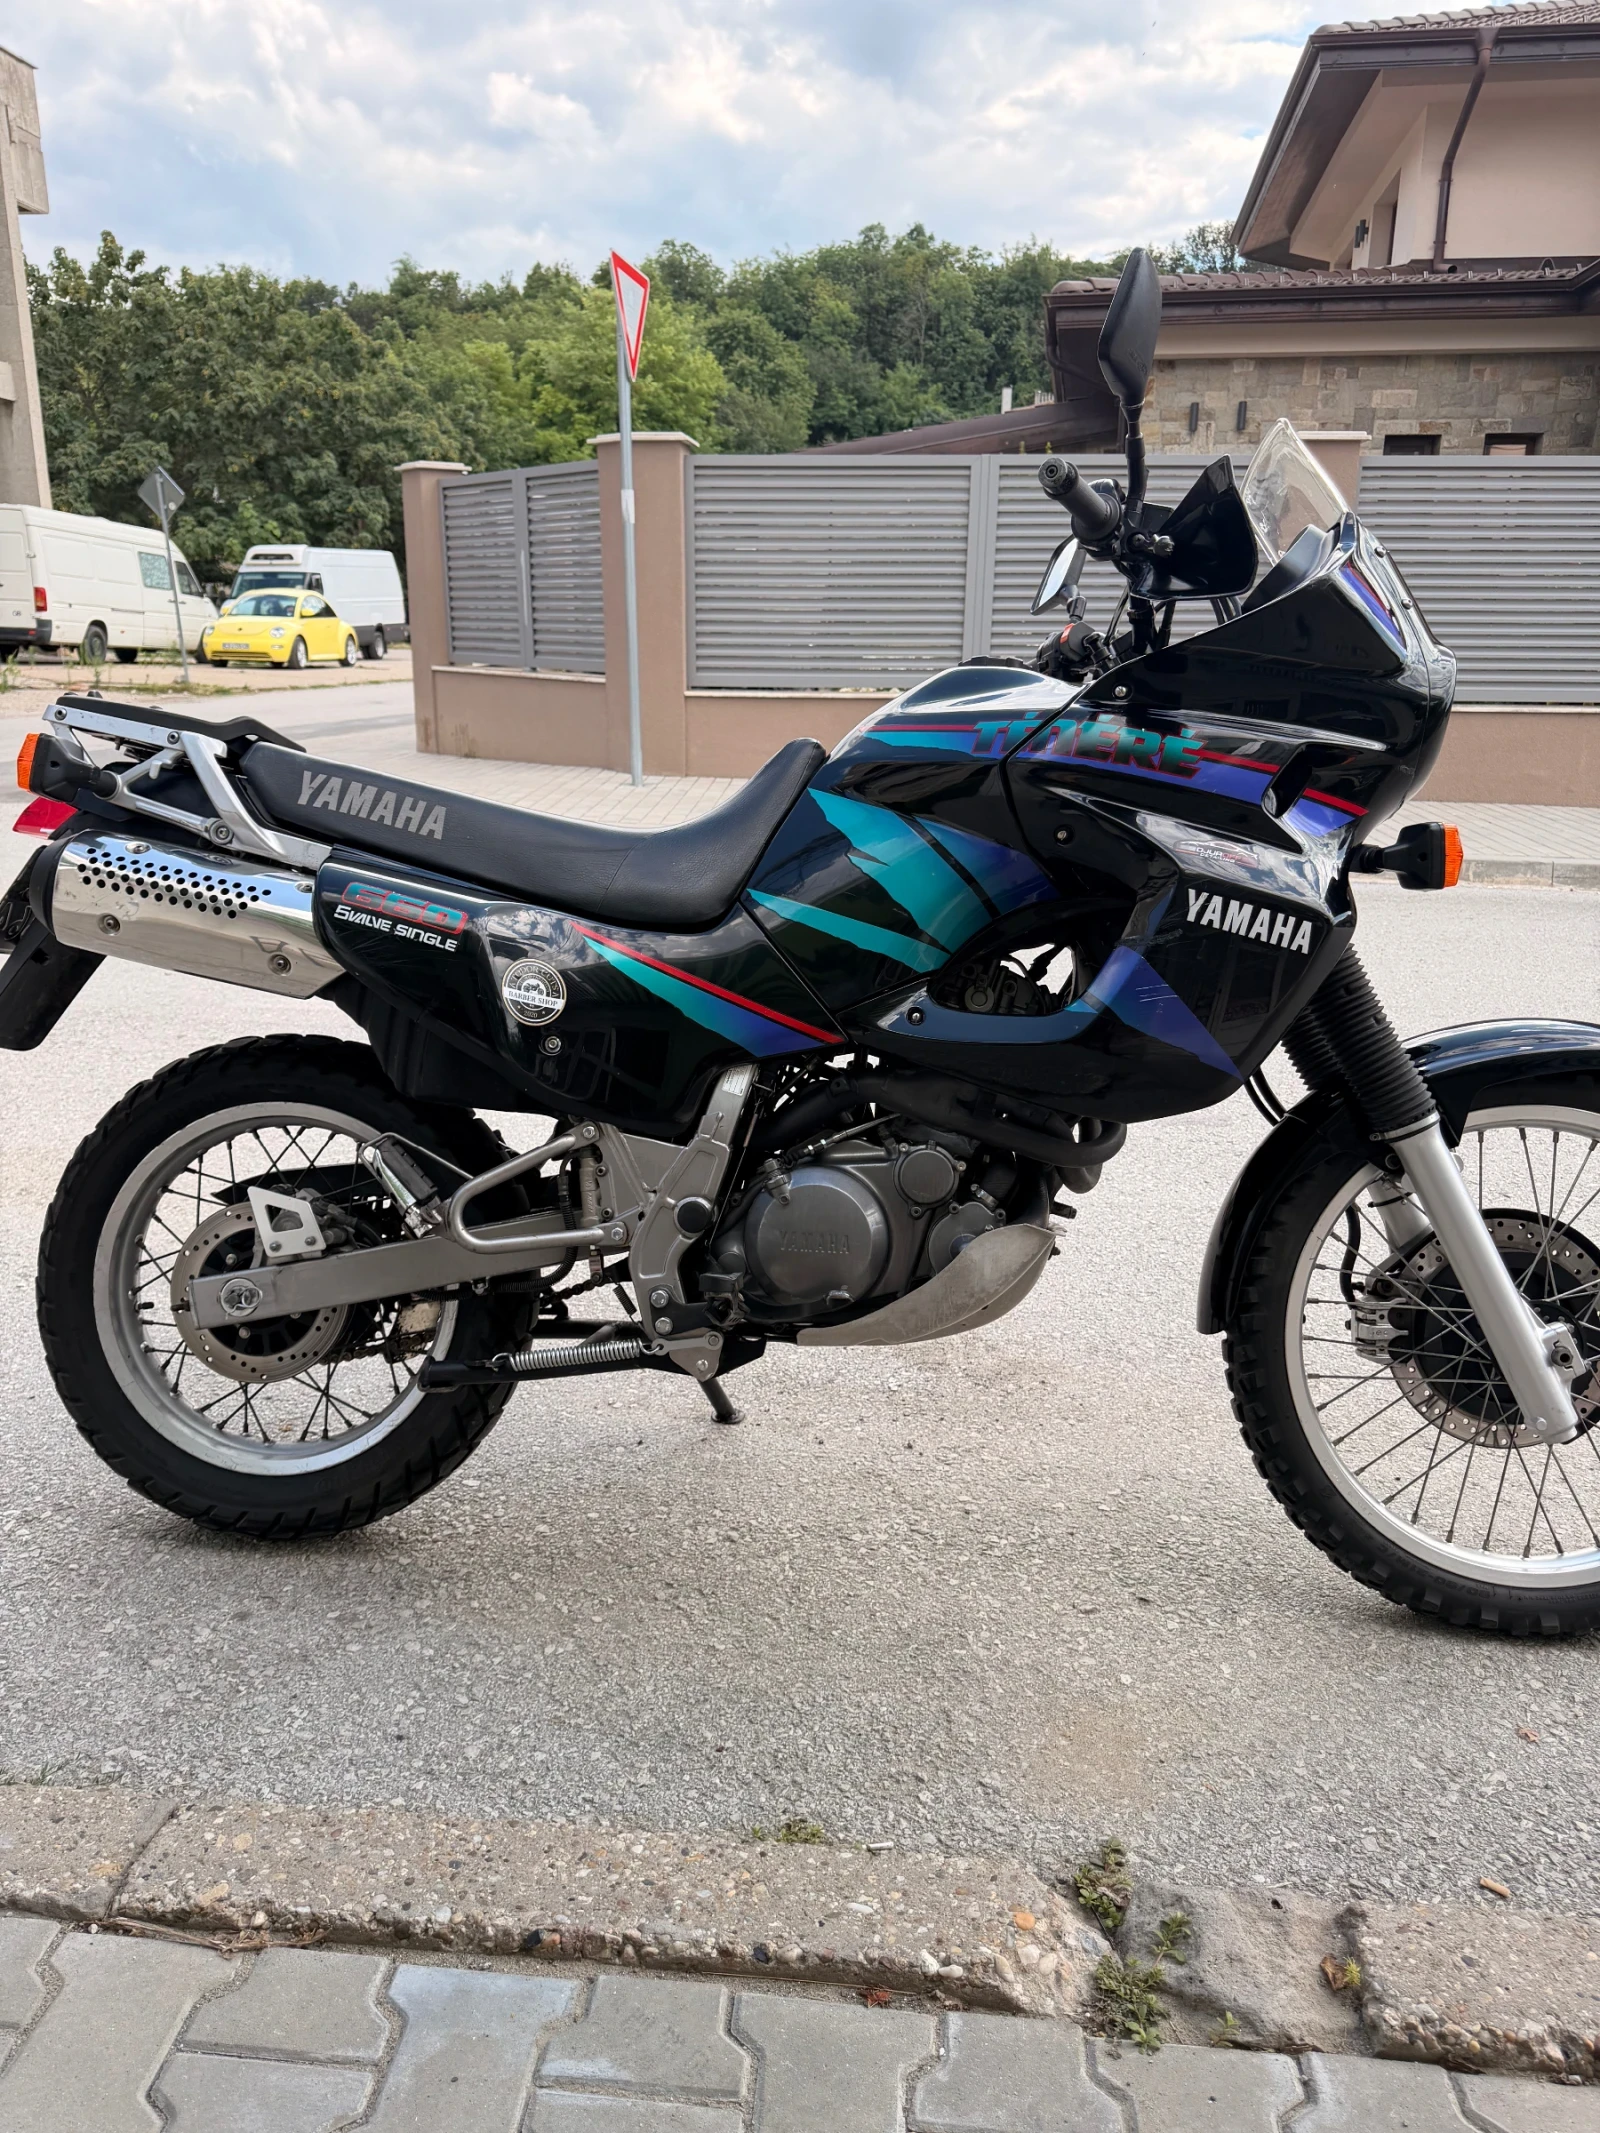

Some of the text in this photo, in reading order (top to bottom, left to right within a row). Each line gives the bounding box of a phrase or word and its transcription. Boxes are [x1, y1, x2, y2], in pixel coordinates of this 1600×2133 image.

[297, 770, 447, 840] YAMAHA
[341, 882, 468, 934] 660
[1186, 888, 1313, 955] YAMAHA
[393, 923, 458, 952] SINGLE
[508, 991, 558, 1007] BARBER SHOP
[779, 1228, 852, 1254] YAMAHA
